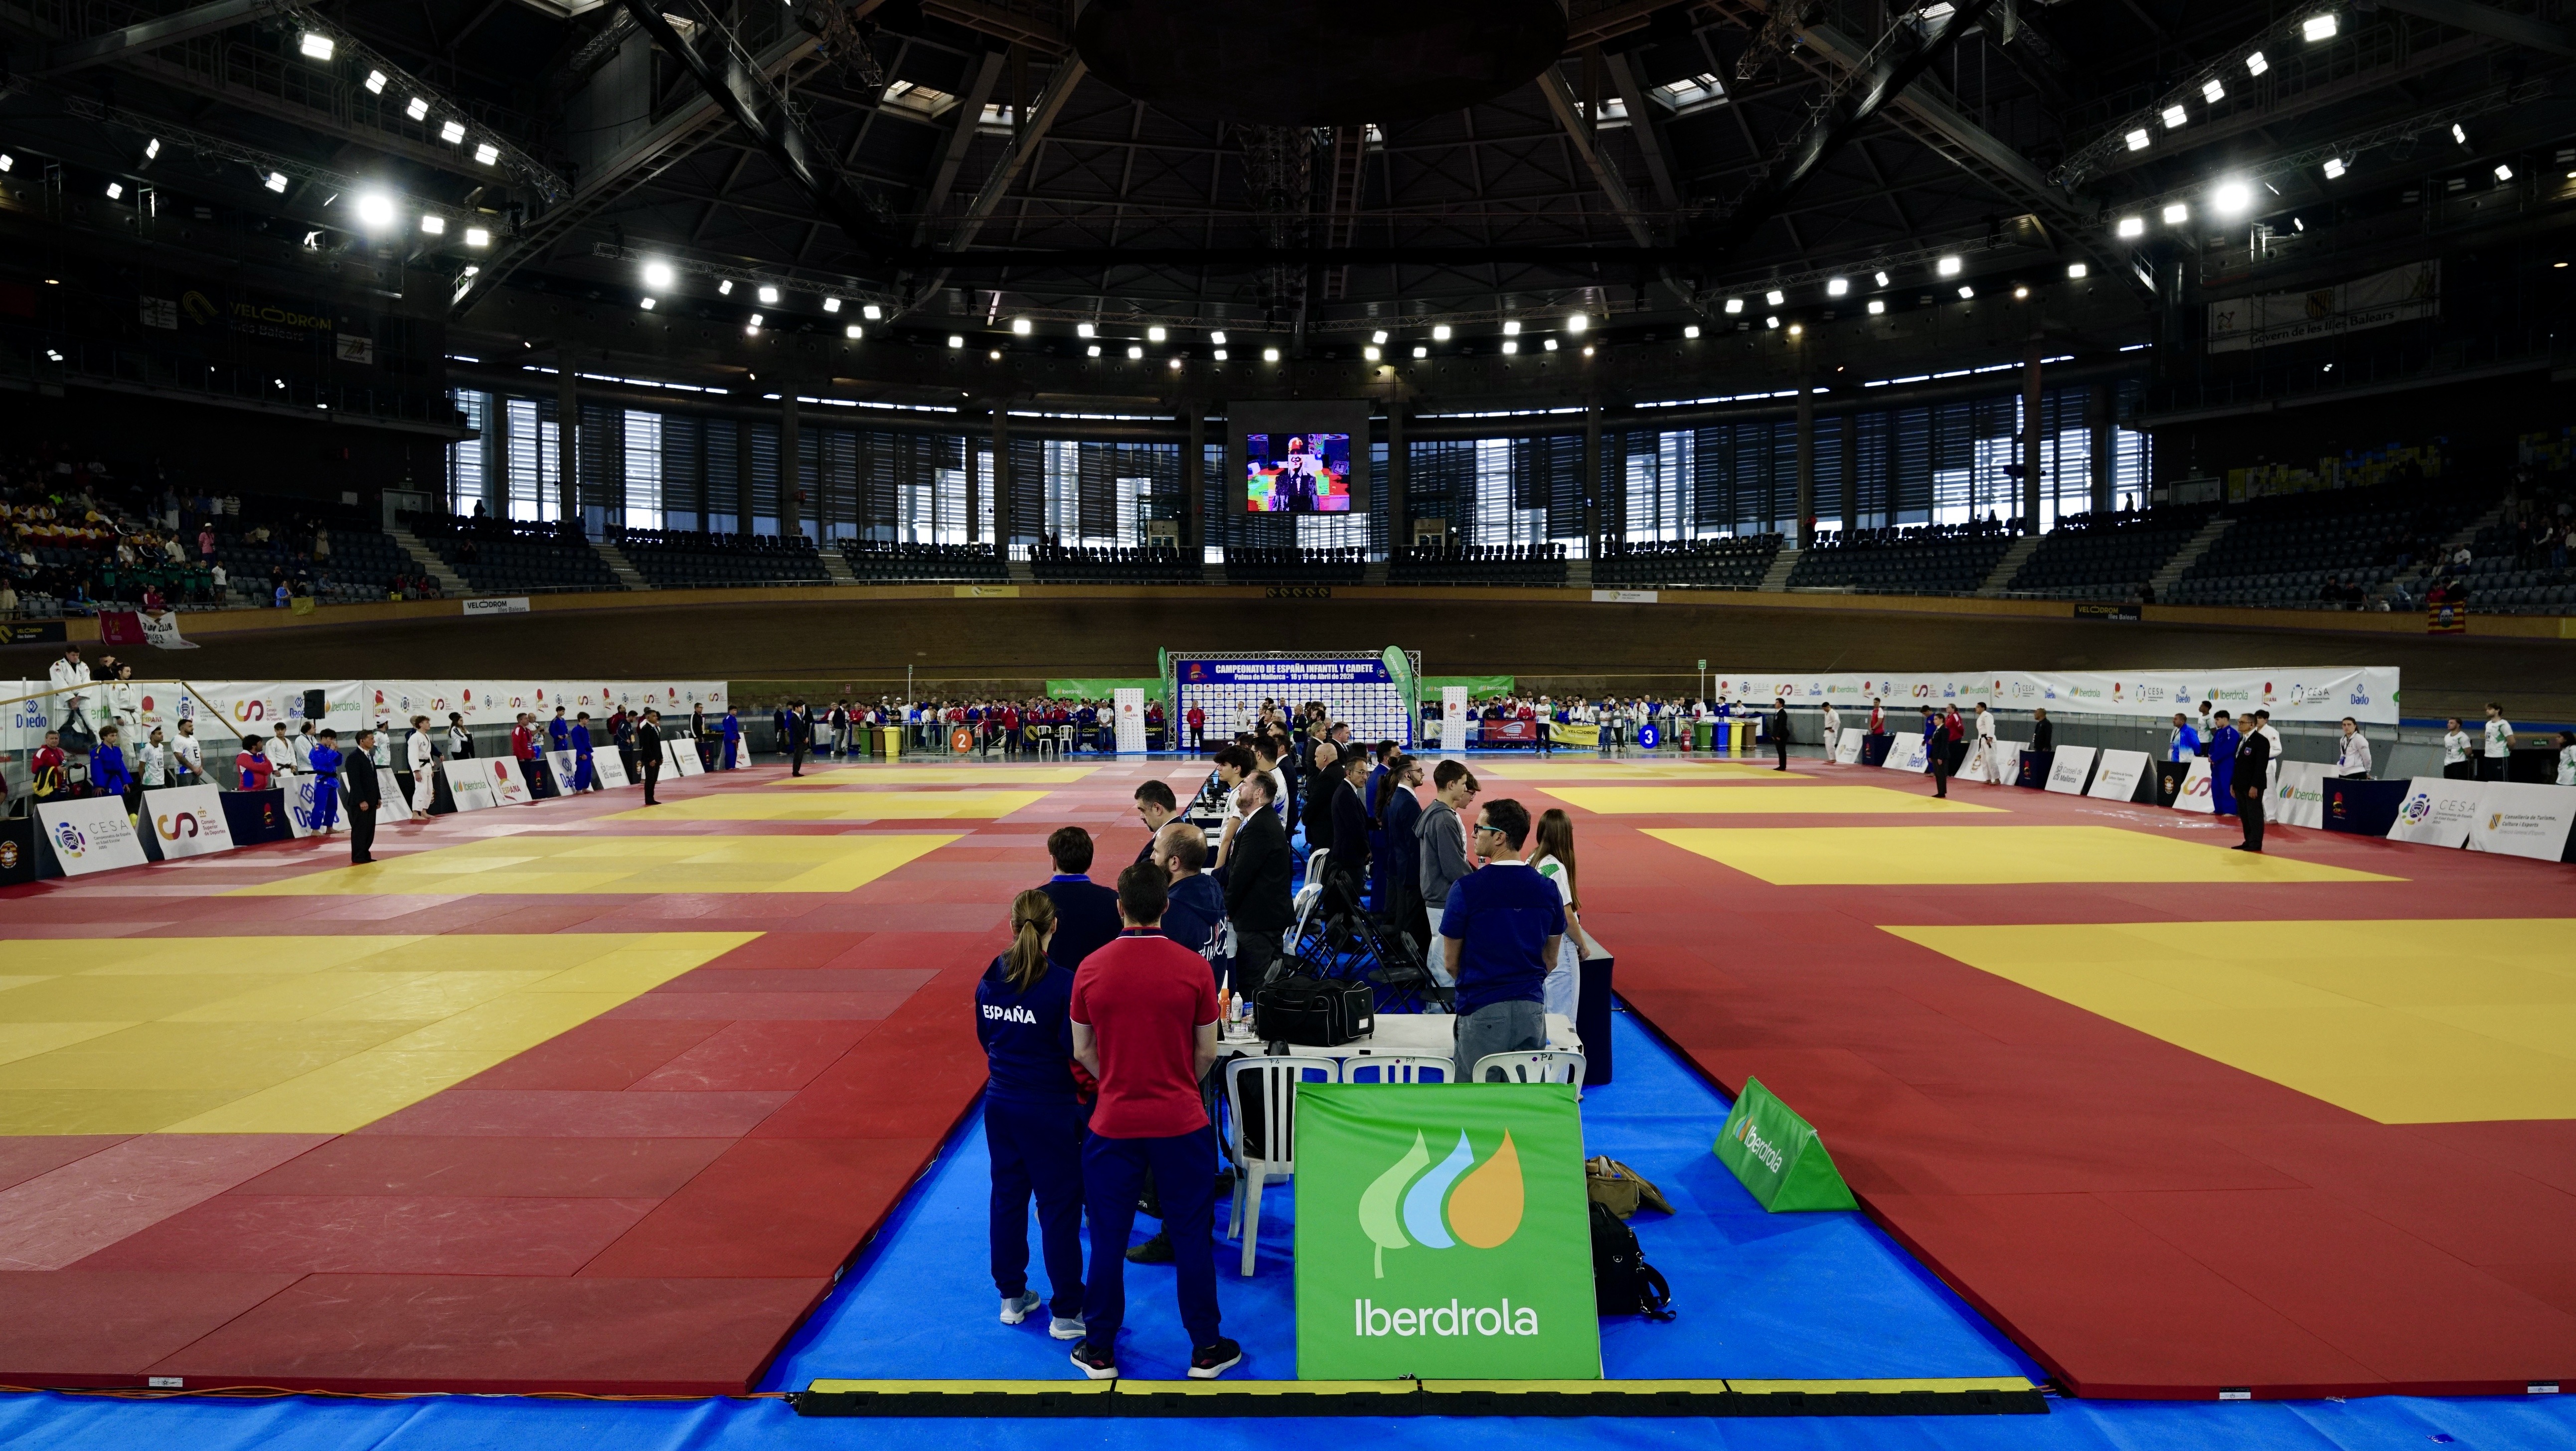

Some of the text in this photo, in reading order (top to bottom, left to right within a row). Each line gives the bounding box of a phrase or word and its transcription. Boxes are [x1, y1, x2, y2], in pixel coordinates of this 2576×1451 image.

[2250, 329, 2289, 344] Govern
[2292, 326, 2305, 336] de
[2307, 322, 2322, 334] les
[2349, 310, 2395, 326] Balears
[1215, 663, 1374, 674] CAMPEONATO DE ESPAÑA INFANTIL Y CADETE
[2079, 689, 2100, 698] Iberdrola
[2148, 687, 2163, 696] CESA
[2220, 689, 2248, 701] Iberdrola
[2307, 688, 2330, 696] CESA
[2176, 694, 2190, 704] Daedo
[330, 700, 361, 712] Iberdrola
[958, 733, 966, 748] 2
[1644, 729, 1653, 744] 3
[2063, 766, 2077, 774] Consell
[2060, 774, 2077, 783] Mallorca
[463, 779, 486, 791] Iberdrola
[503, 783, 521, 795] ESPAÑA
[2439, 800, 2476, 812] CESA
[89, 819, 129, 834] CESA
[982, 1005, 1037, 1024] ESPAÑA
[1744, 1125, 1782, 1174] Iberdrola
[1355, 1298, 1539, 1337] Iberdrola
